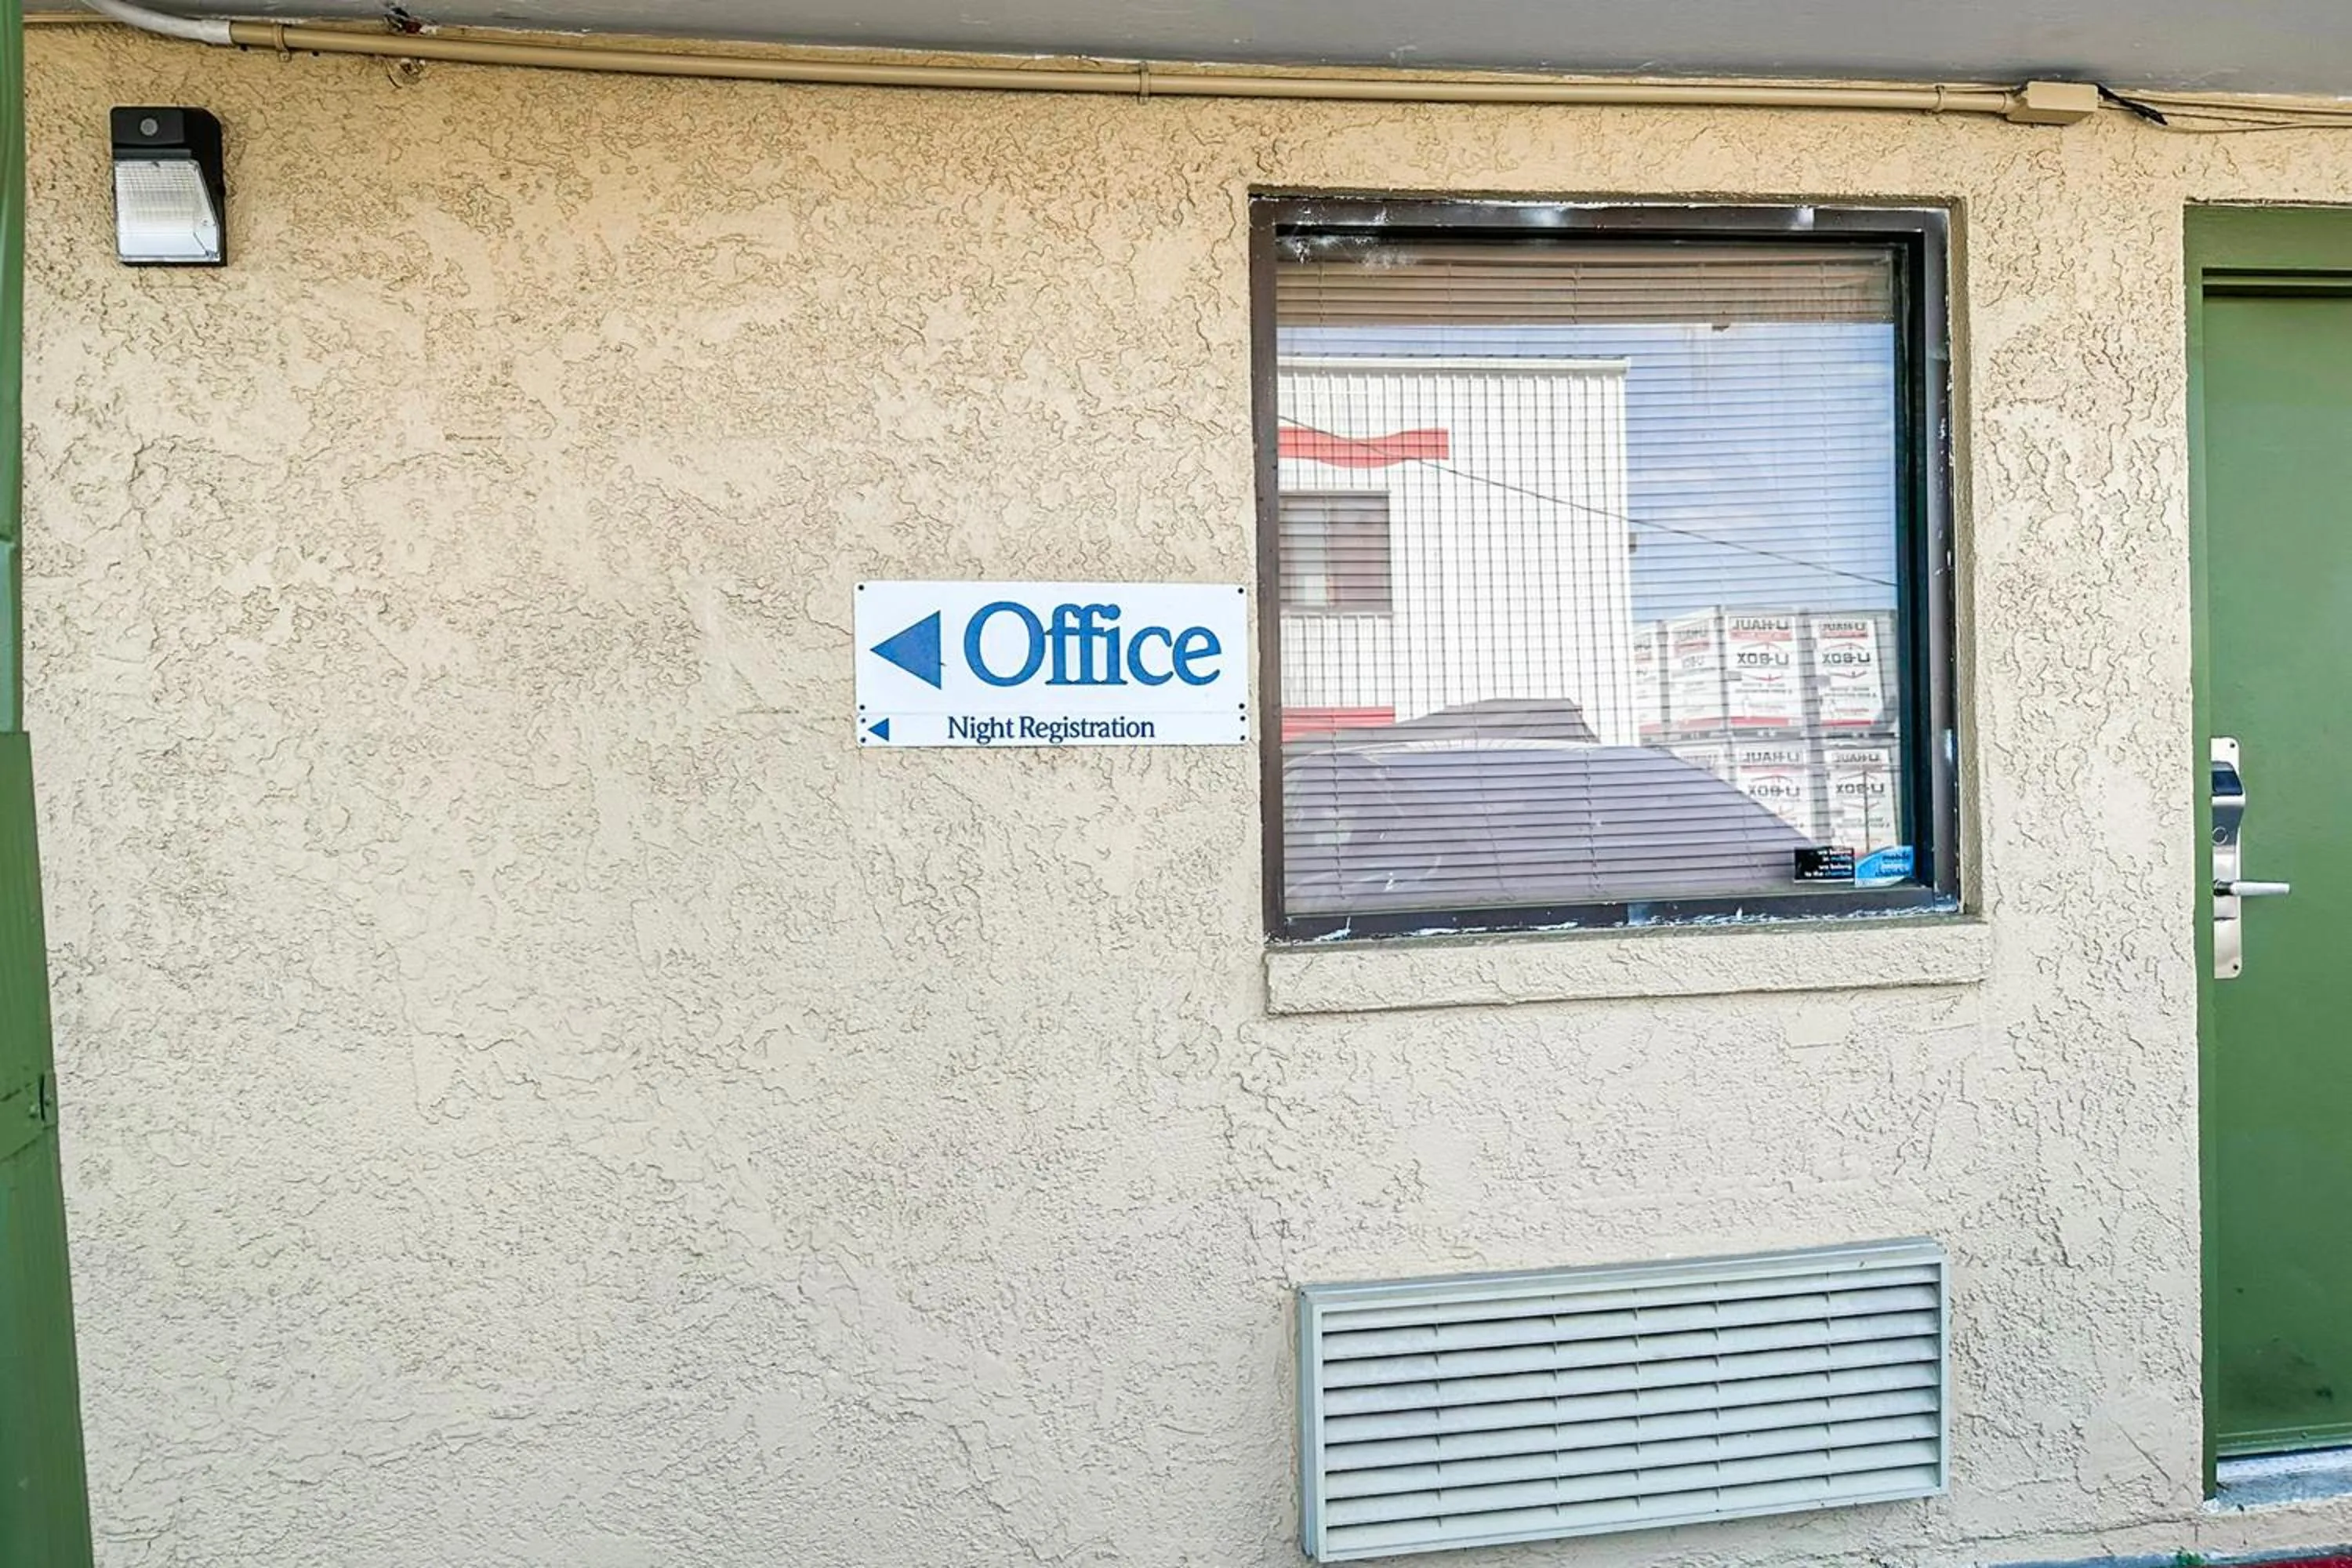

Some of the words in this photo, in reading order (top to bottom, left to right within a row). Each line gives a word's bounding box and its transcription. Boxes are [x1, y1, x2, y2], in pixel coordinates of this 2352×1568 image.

[964, 601, 1222, 687] Office
[948, 716, 1014, 745] Night
[1020, 716, 1156, 745] Registration
